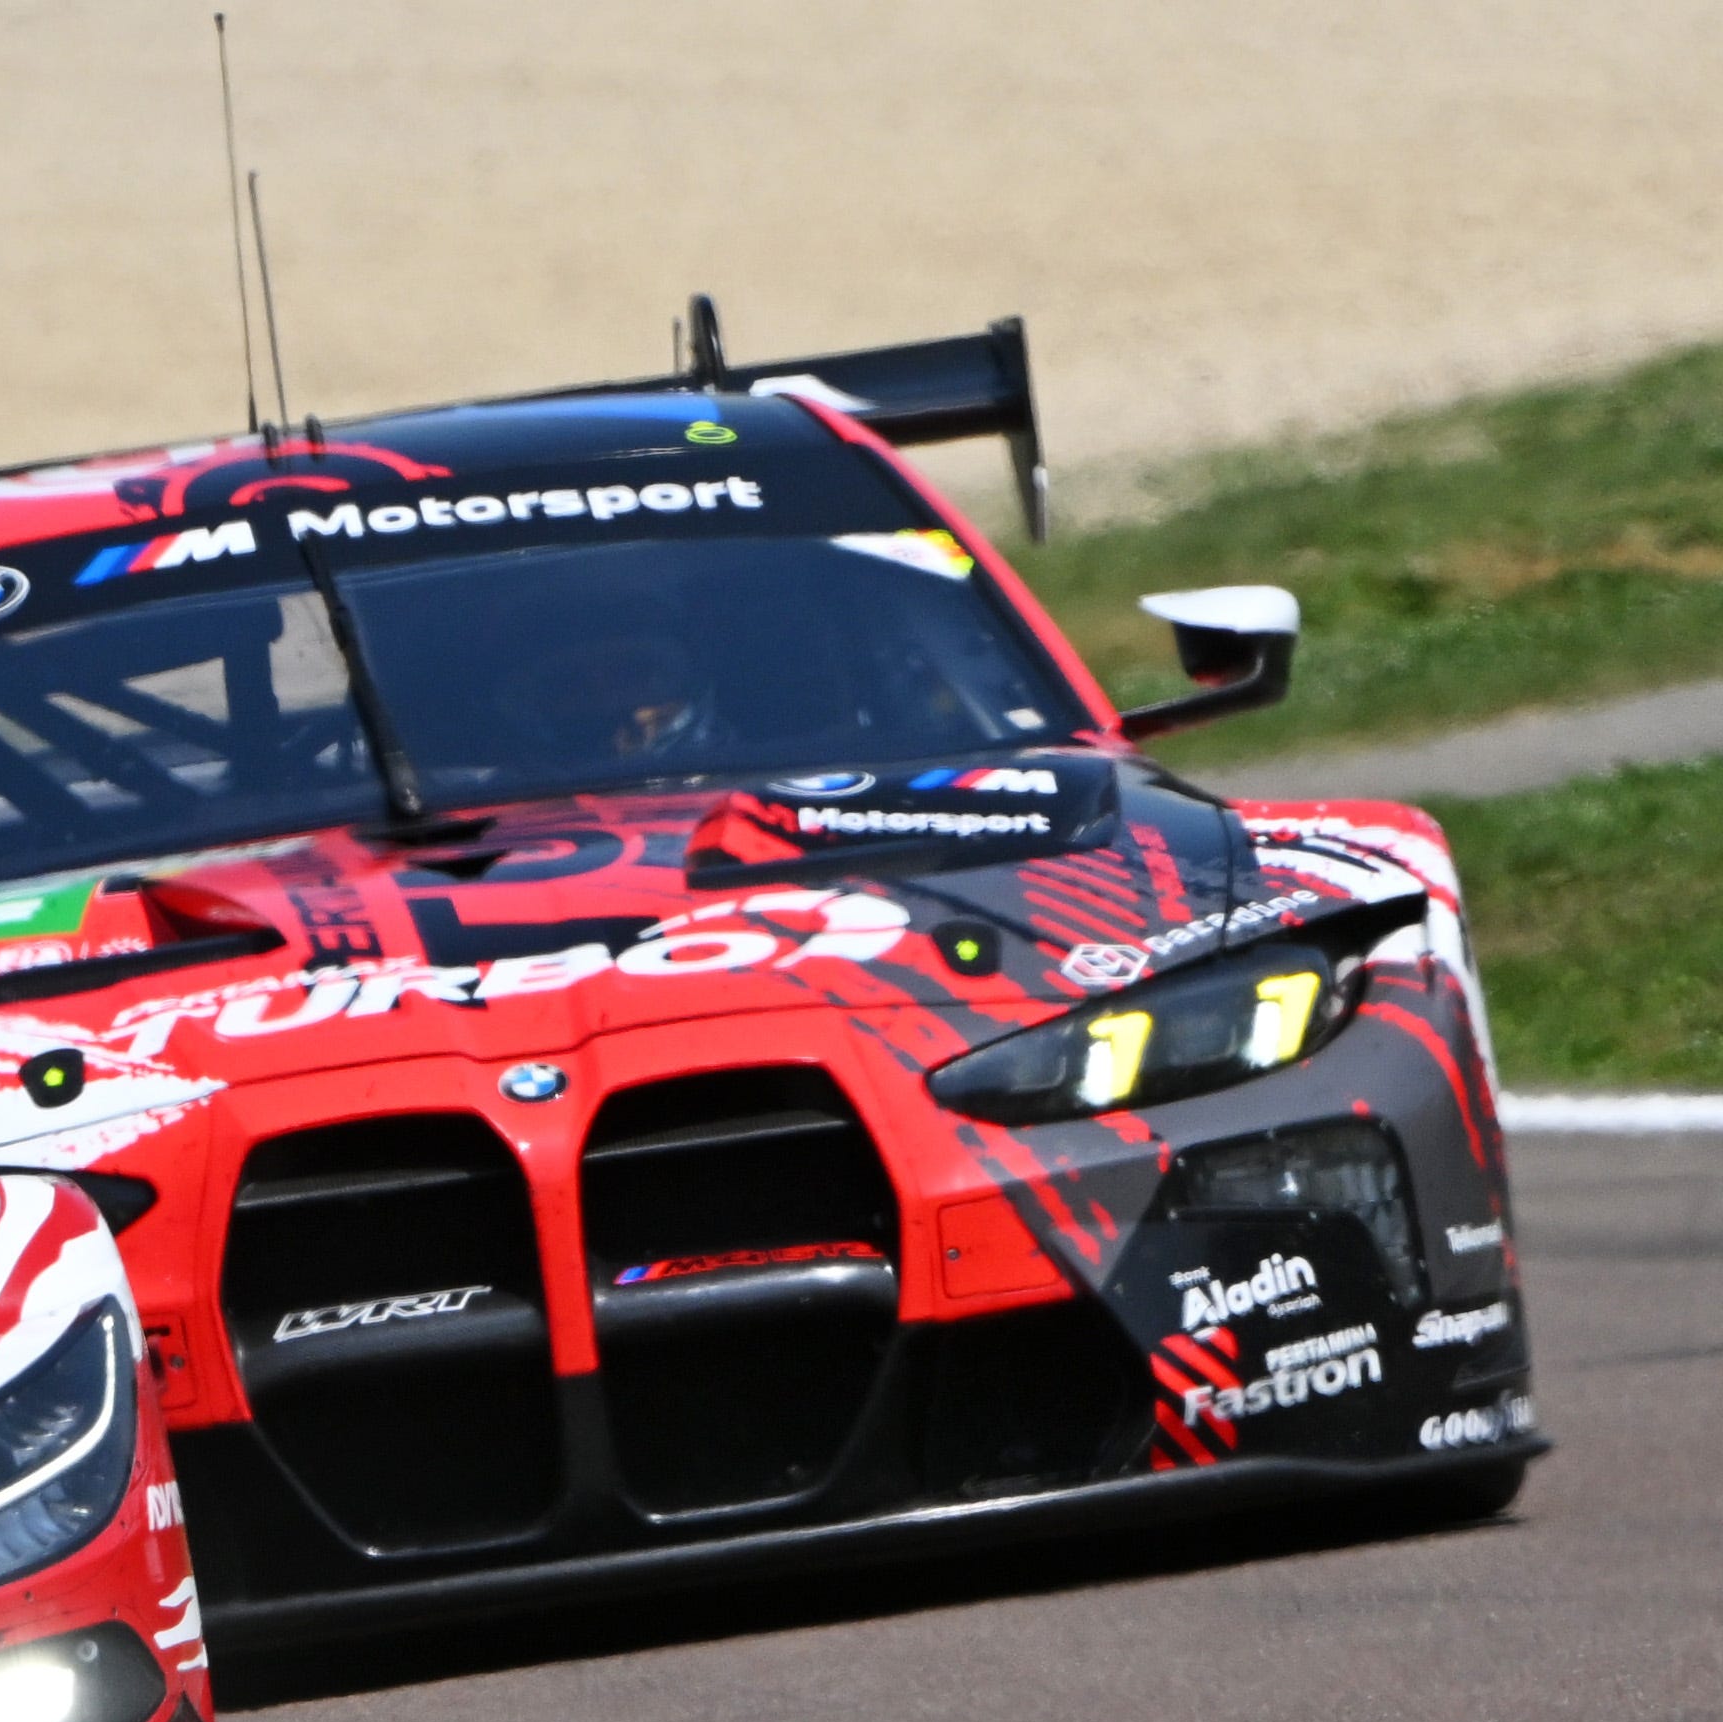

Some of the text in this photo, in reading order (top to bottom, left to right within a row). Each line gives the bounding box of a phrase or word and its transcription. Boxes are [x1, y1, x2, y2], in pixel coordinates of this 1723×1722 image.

[287, 475, 763, 541] Motorsport
[798, 806, 1051, 839] Motorsport
[271, 1285, 494, 1344] WRT
[1180, 1252, 1319, 1332] Aladin
[1264, 1322, 1379, 1374] PERTAMINA
[1182, 1347, 1383, 1428] Fastron
